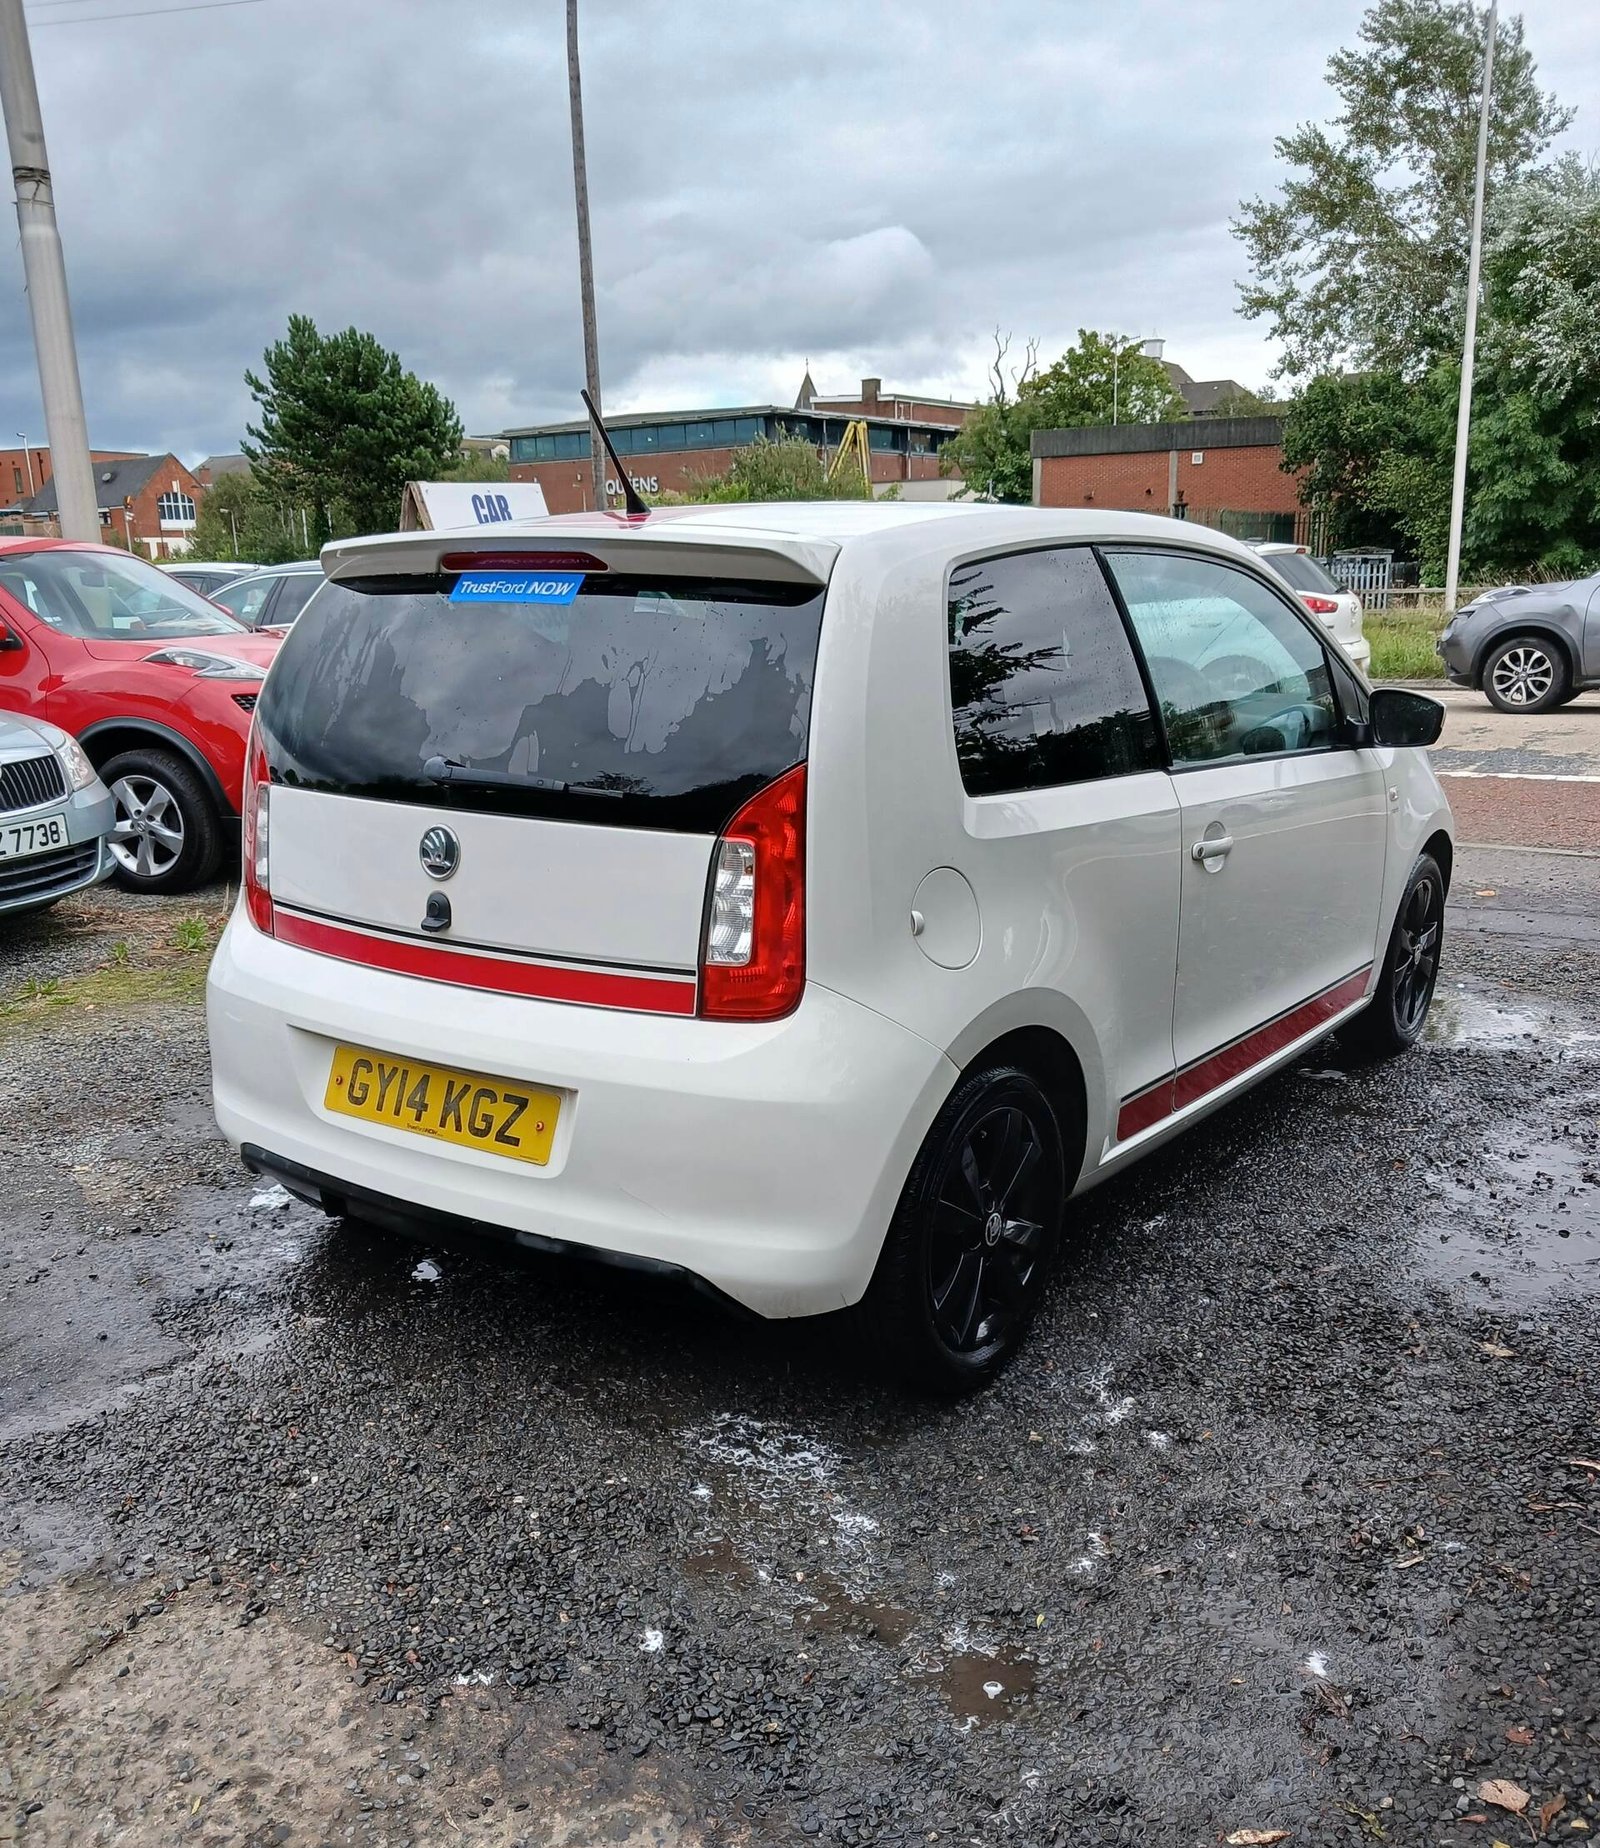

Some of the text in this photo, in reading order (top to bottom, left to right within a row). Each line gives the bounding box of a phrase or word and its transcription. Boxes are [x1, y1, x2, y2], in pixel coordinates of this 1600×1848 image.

[605, 476, 659, 496] QUENS
[471, 494, 513, 524] CAR
[460, 580, 576, 596] TrustFord NOW
[8, 820, 61, 853] 7738
[347, 1058, 529, 1147] GY14 KGZ
